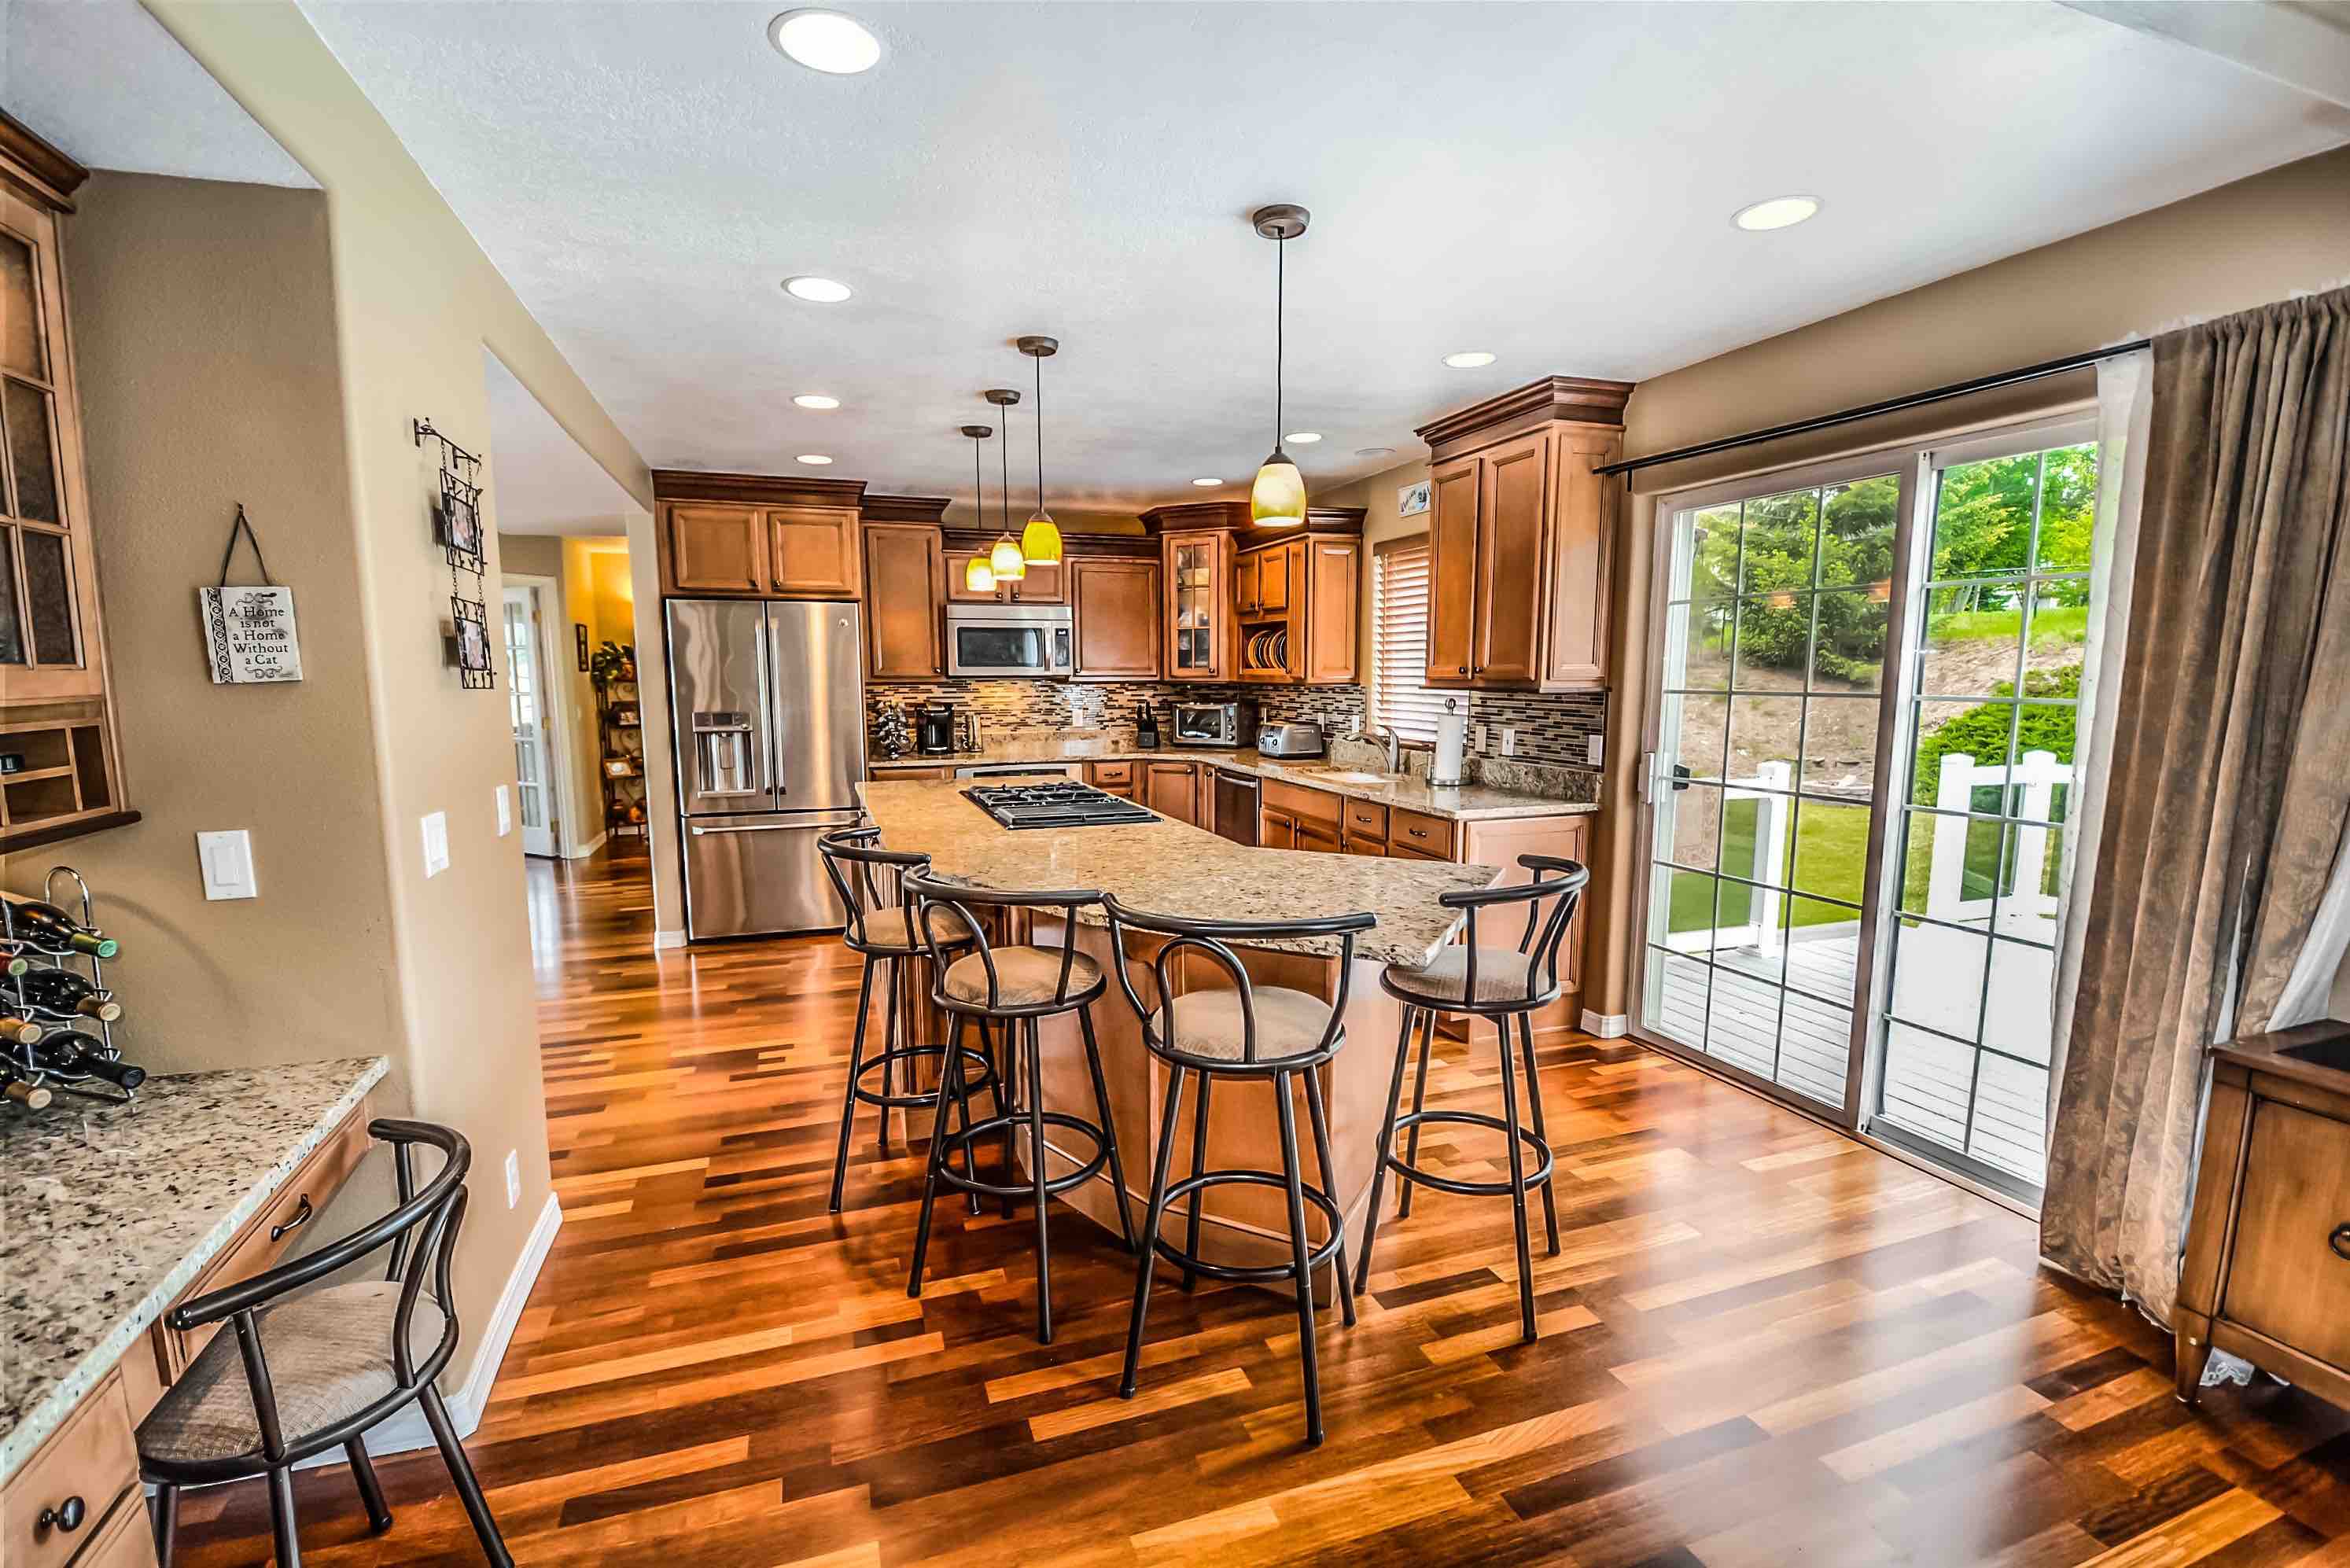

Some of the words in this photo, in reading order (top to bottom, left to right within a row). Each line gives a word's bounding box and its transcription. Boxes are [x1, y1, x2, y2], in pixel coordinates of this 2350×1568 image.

[229, 607, 239, 617] A
[243, 605, 285, 617] Home
[240, 617, 252, 628] is
[253, 620, 276, 628] not
[244, 630, 285, 641] Home
[233, 642, 289, 653] Without
[255, 654, 278, 664] Cat
